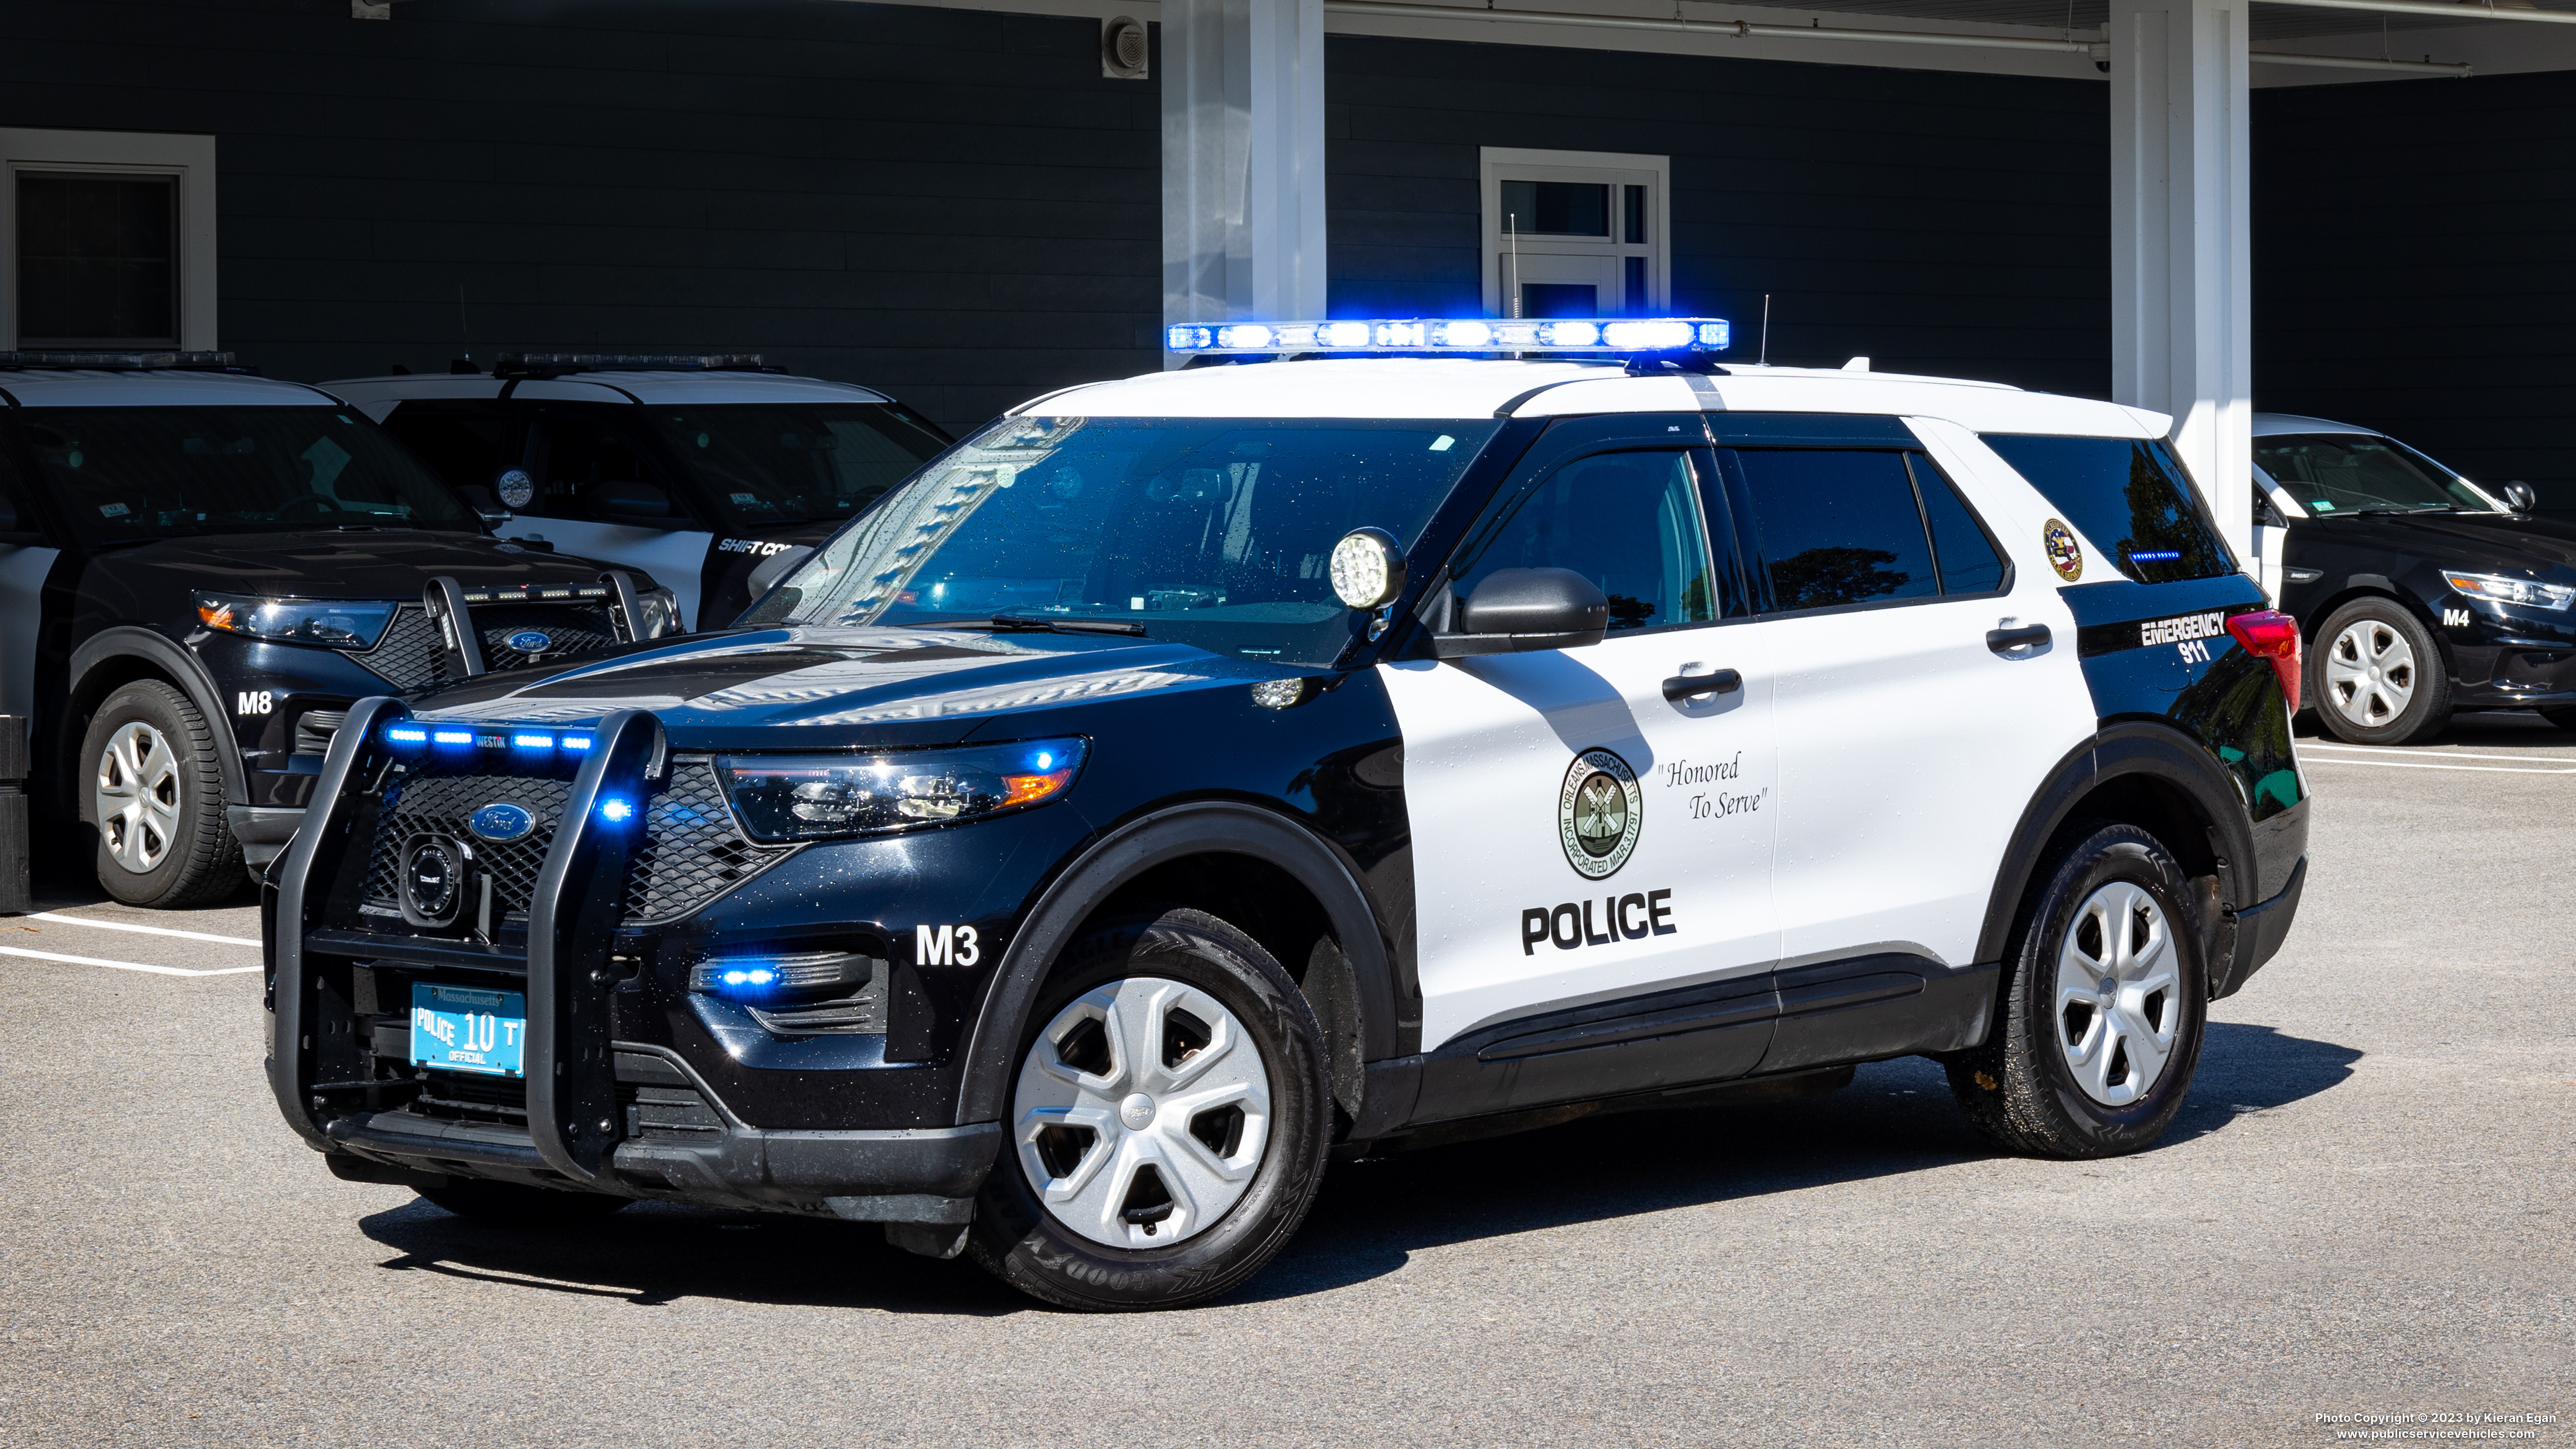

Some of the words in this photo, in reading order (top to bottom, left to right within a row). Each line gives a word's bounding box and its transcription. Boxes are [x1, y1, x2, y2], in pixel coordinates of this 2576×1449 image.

[719, 539, 764, 554] SHIFT
[2142, 611, 2225, 647] EMERGENCY
[2444, 608, 2469, 626] M4
[520, 636, 542, 648] Ford
[2178, 640, 2211, 664] 911
[239, 691, 272, 715] M8
[1690, 792, 1711, 819] To
[1715, 787, 1767, 818] Serve"
[482, 810, 516, 831] Ford
[1563, 818, 1608, 874] INCORPORATED
[1522, 888, 1677, 956] POLICE
[917, 925, 979, 967] M3
[438, 989, 500, 1007] Massachusetts
[417, 1006, 455, 1047] POLICE
[464, 1010, 495, 1053] 10
[504, 1022, 518, 1046] T
[449, 1051, 486, 1065] OFFICIAL
